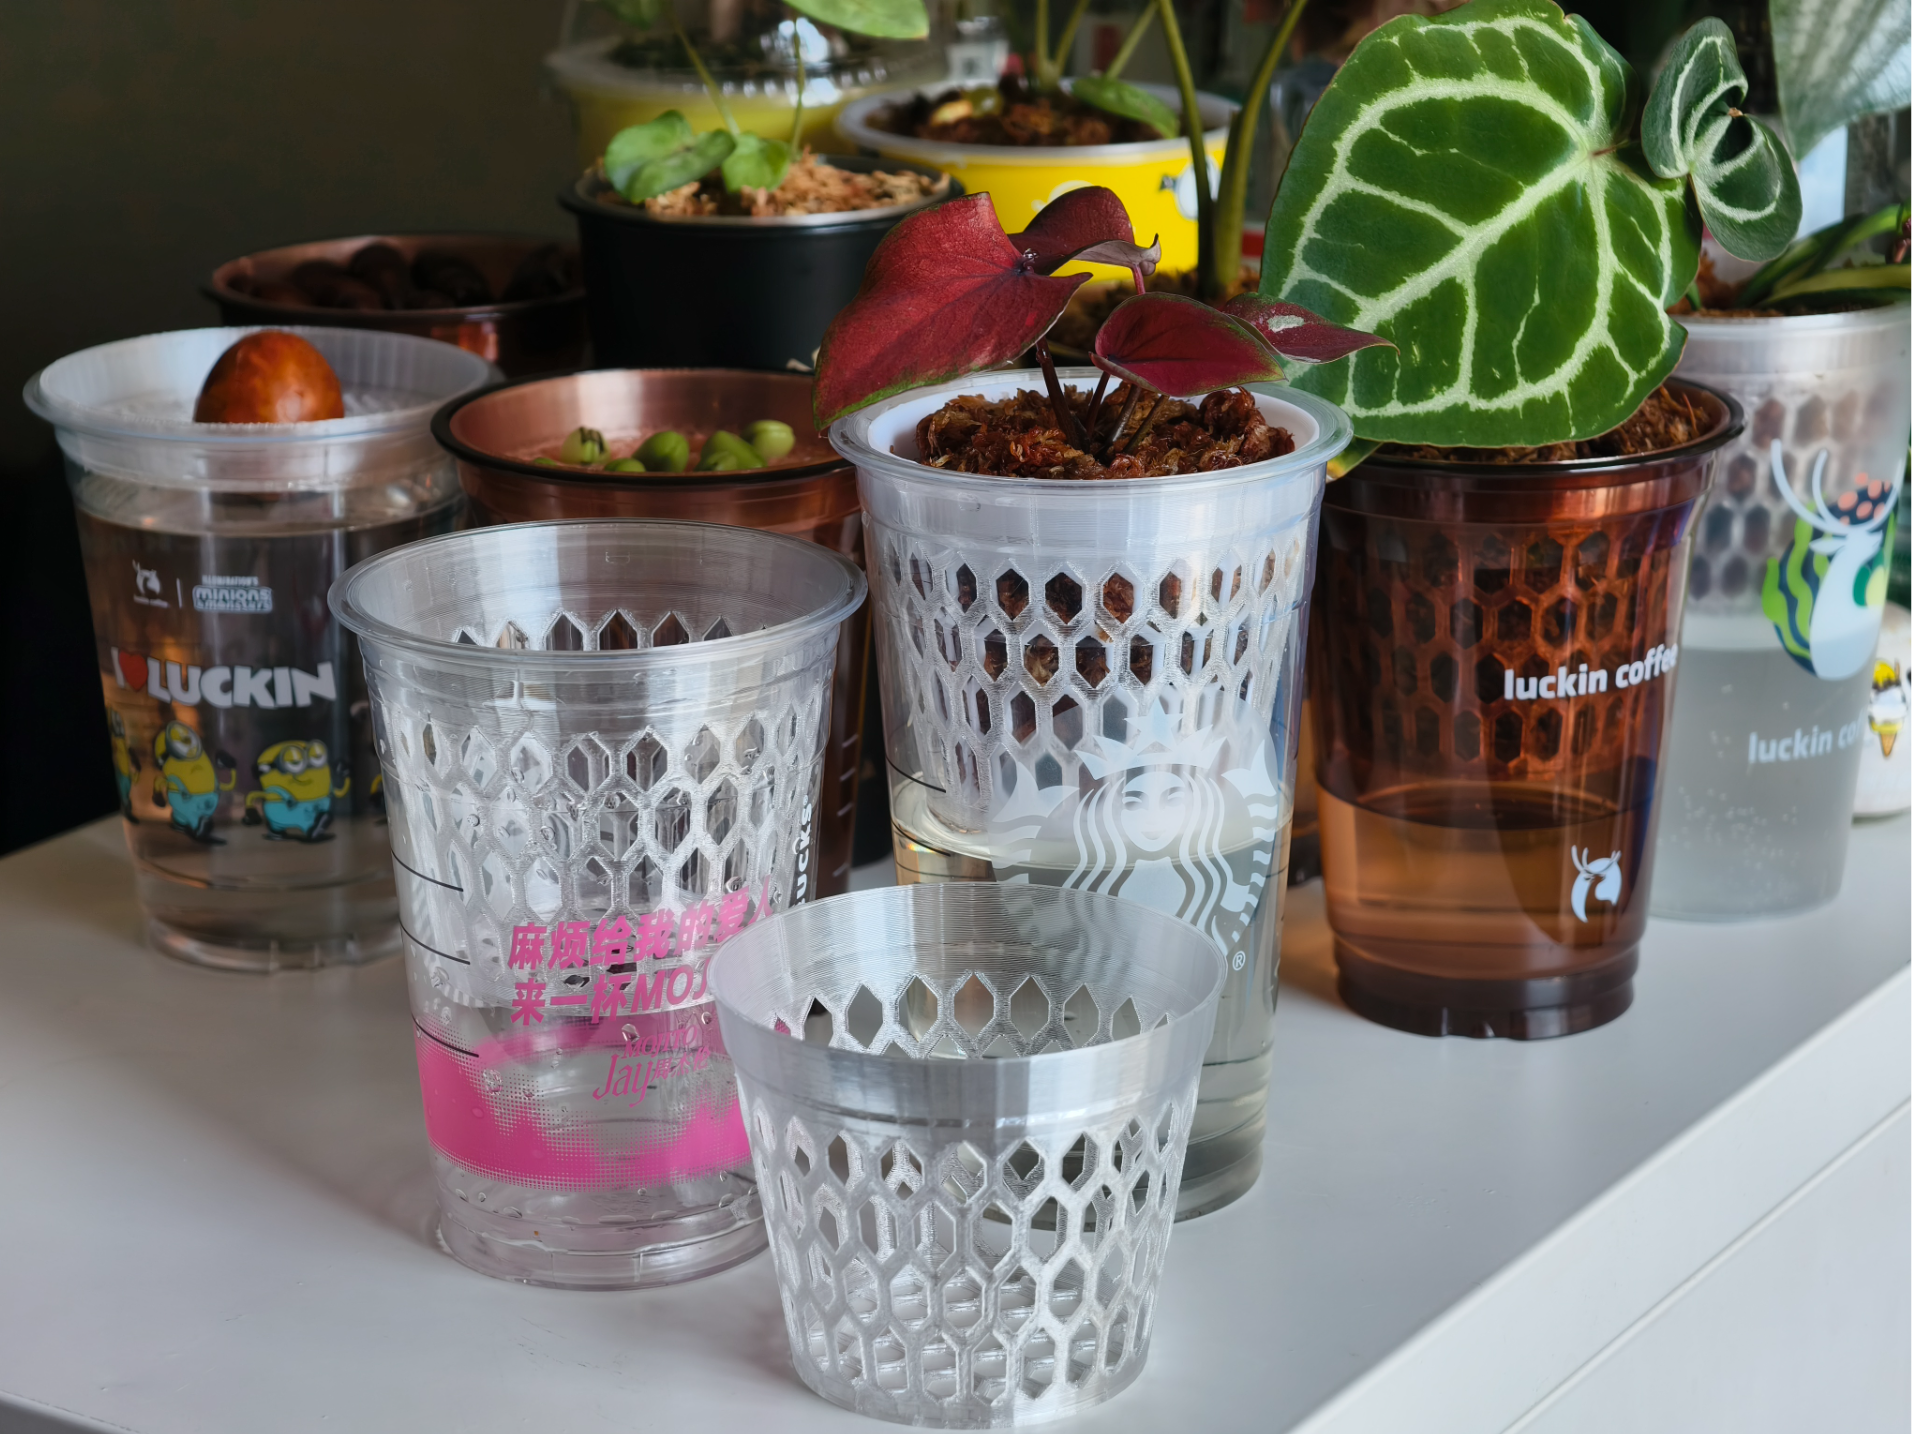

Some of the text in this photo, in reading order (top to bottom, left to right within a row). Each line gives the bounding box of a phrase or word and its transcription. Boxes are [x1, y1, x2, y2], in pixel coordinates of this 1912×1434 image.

[147, 657, 337, 709] LUCKIN
[1504, 643, 1678, 700] luckin coffee
[1748, 725, 1832, 763] luckin
[507, 875, 773, 970] 麻烦给我的爱人
[510, 958, 711, 1025] 来一杯MOJ
[621, 1025, 697, 1059] MOJITO
[592, 1045, 711, 1108] Jay 周杰伦
